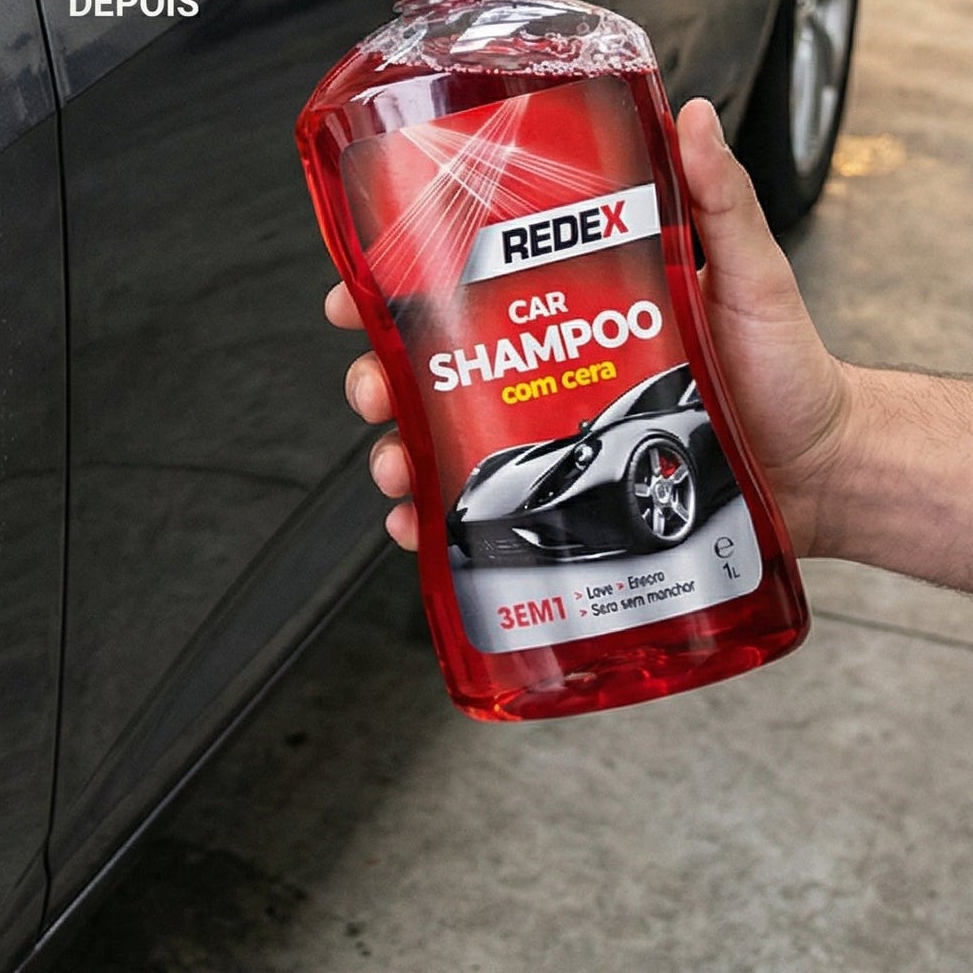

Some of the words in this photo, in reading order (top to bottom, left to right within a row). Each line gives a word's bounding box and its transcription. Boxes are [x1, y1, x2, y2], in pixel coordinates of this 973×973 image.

[502, 200, 629, 264] REDEX
[508, 290, 568, 324] CAR
[429, 300, 663, 392] SHAMPOO
[501, 375, 558, 405] com
[561, 359, 617, 387] cera
[496, 595, 568, 631] 3EM1
